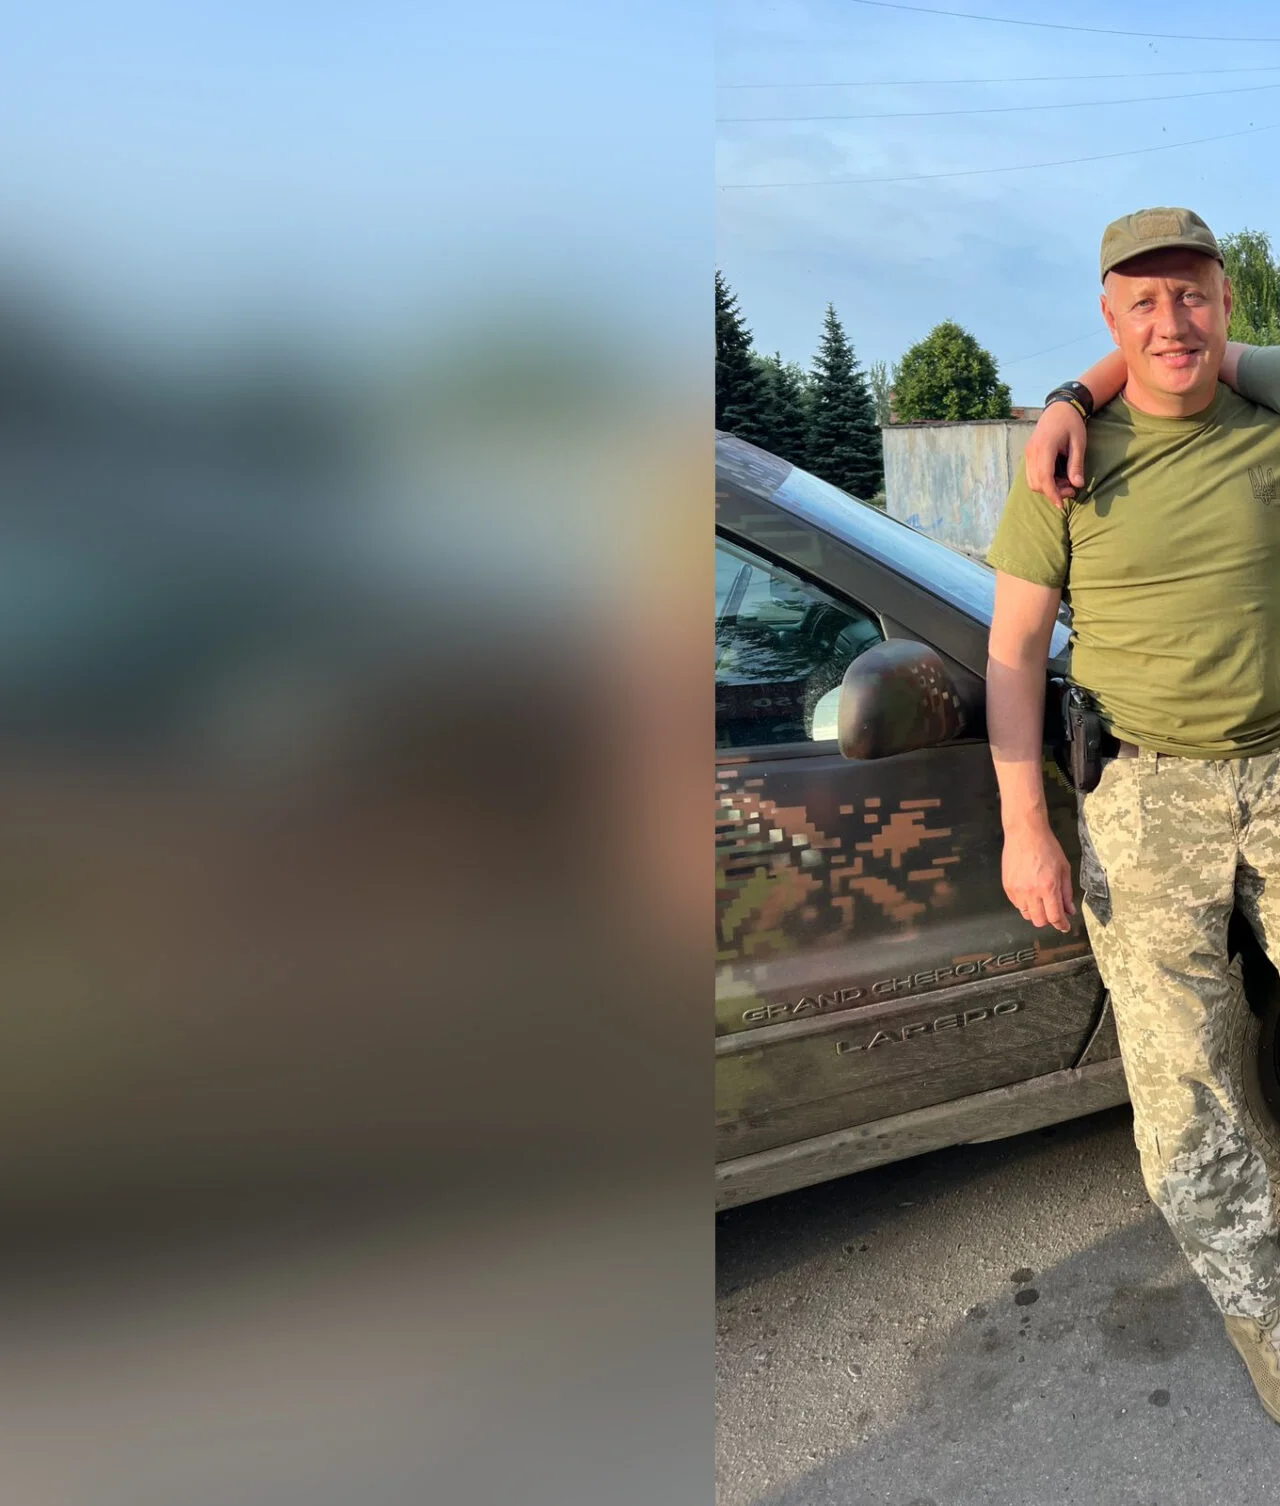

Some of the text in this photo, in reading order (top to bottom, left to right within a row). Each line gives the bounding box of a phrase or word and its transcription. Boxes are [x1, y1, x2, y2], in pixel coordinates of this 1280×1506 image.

[742, 948, 1038, 1024] GRAND CHEROKEE
[836, 1000, 1025, 1056] LAREDO
